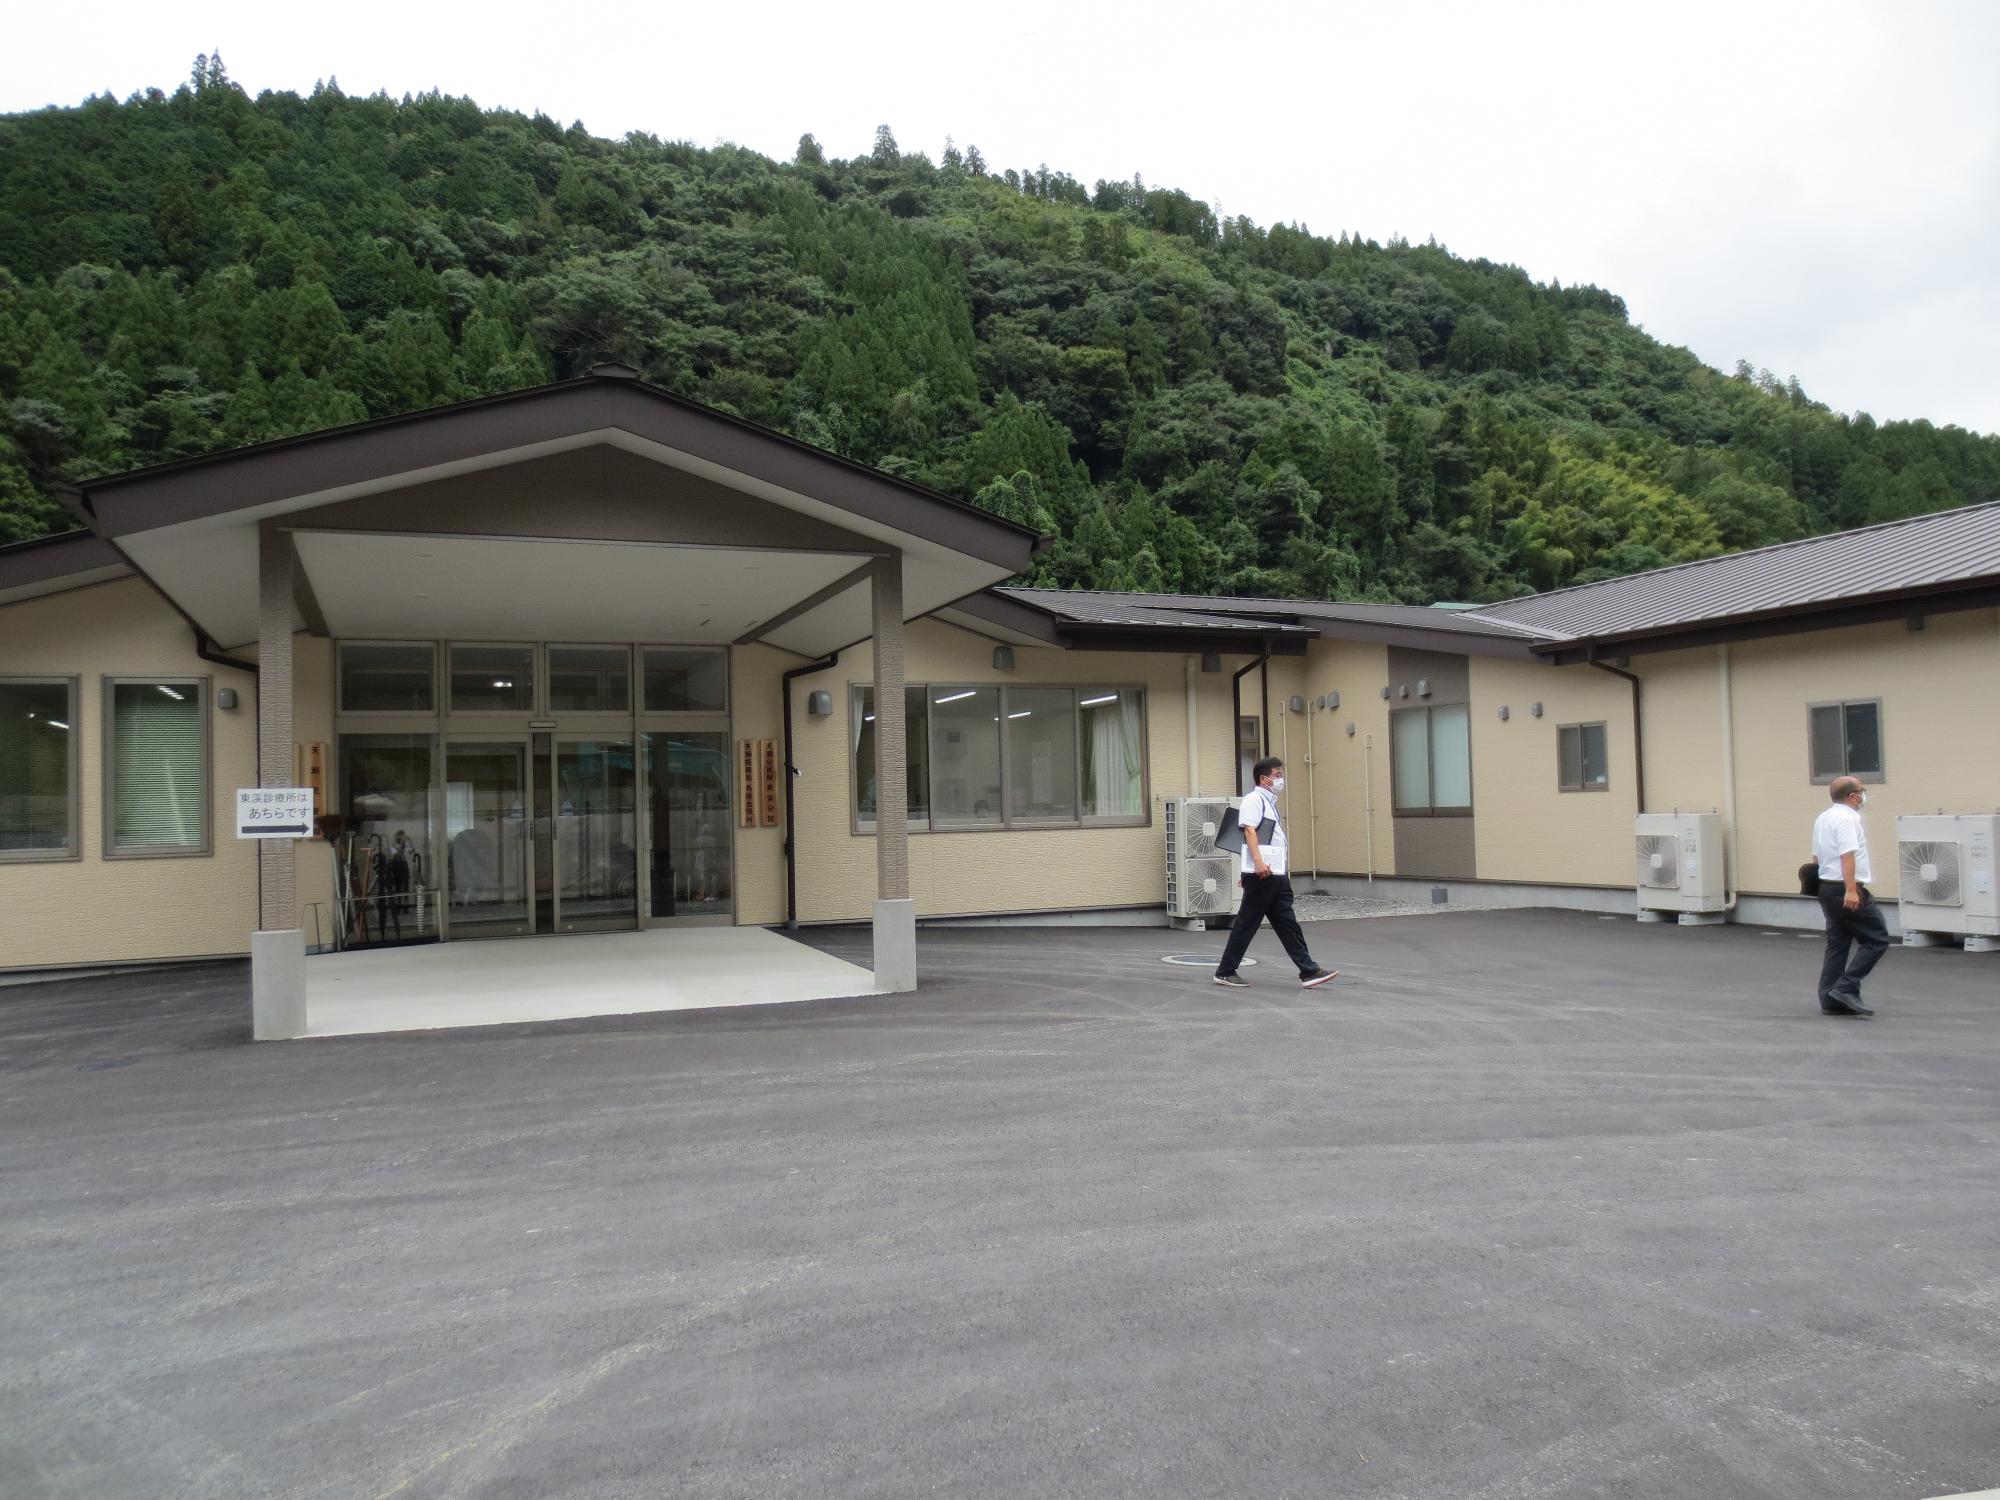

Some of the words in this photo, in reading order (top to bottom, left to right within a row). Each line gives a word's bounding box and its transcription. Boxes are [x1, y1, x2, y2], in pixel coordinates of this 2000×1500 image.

[249, 807, 310, 820] あちらです
